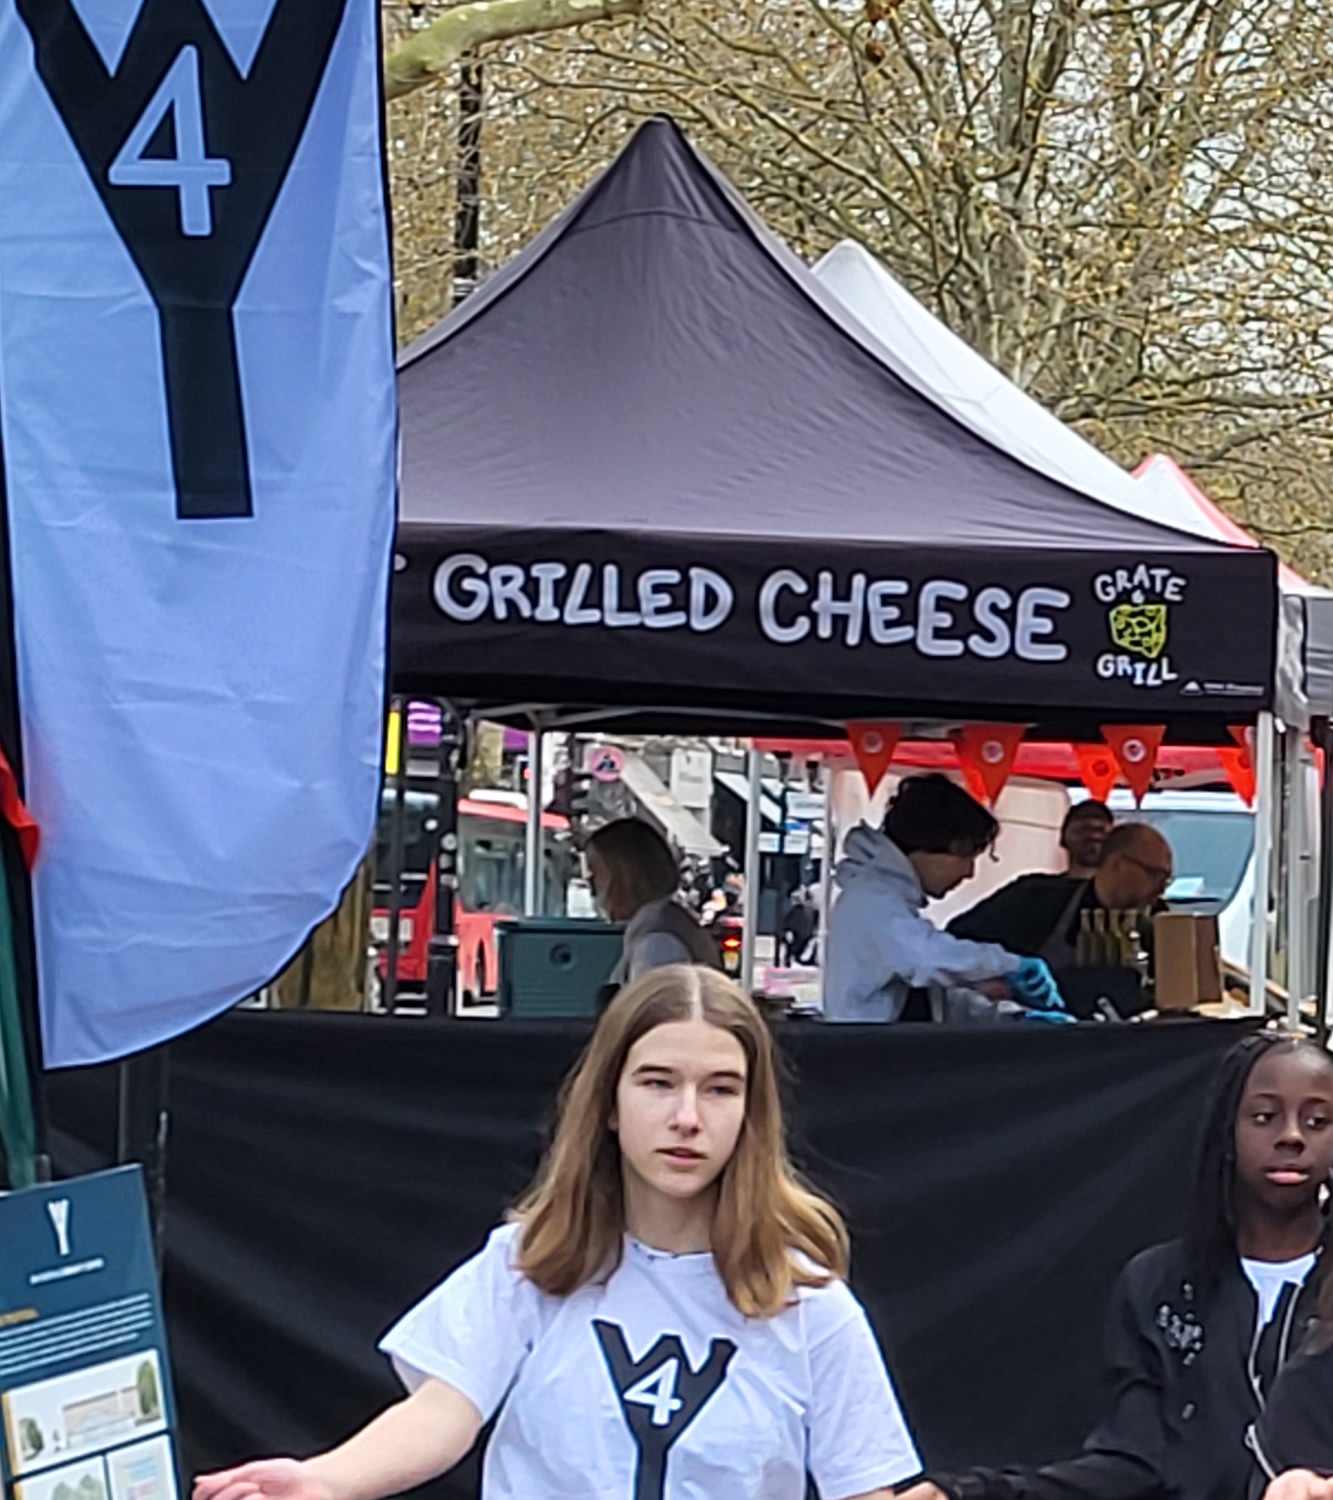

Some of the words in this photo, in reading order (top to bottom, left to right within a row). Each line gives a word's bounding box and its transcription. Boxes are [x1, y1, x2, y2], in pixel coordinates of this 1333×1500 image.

[1094, 564, 1187, 602] GRATE
[434, 554, 733, 631] GRILLED
[758, 569, 1069, 660] CHEESE
[1097, 654, 1179, 686] GRILL
